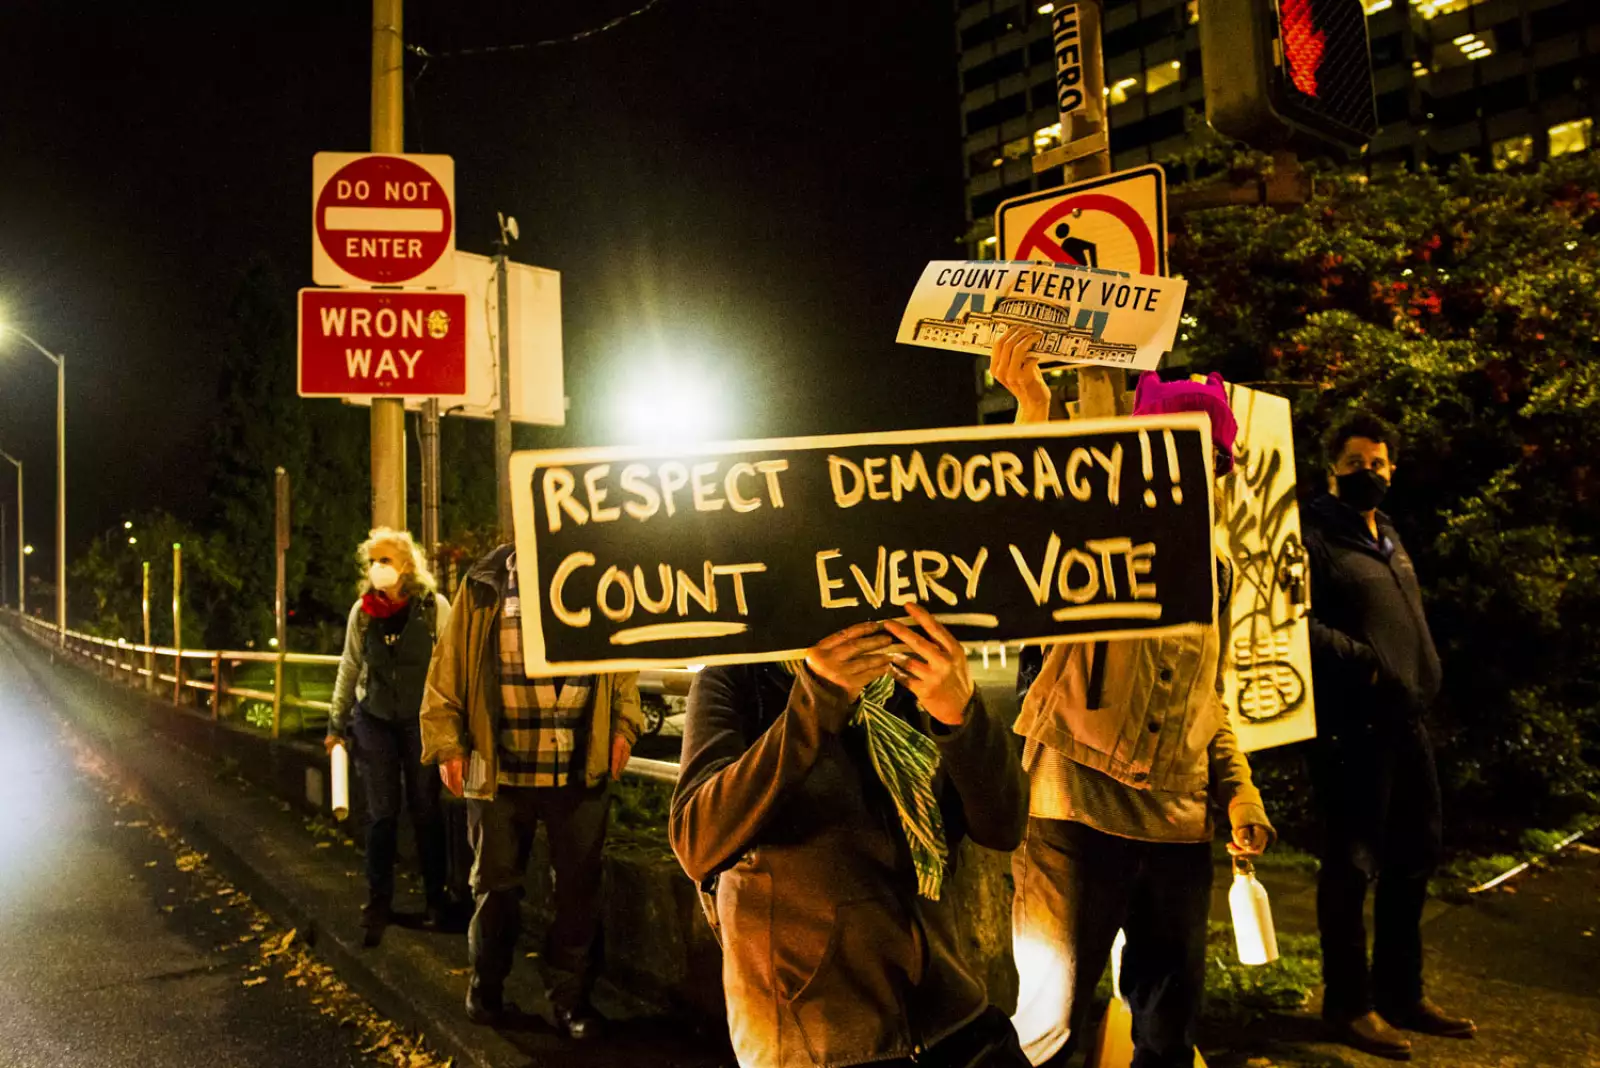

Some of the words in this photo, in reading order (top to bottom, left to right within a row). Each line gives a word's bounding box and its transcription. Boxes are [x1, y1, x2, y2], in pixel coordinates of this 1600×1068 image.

[1053, 6, 1083, 113] HIERO
[337, 180, 371, 201] DO
[384, 181, 432, 202] NOT
[346, 238, 422, 259] ENTER
[936, 268, 1010, 290] COUNT
[1013, 269, 1092, 303] EVERY
[1101, 282, 1162, 312] VOTE
[345, 348, 423, 379] WAY
[543, 458, 789, 533] RESPECT
[828, 428, 1185, 509] DEMOCRACY!!
[549, 551, 768, 628] COUNT
[816, 545, 989, 610] EVERY
[1009, 531, 1158, 607] VOTE
